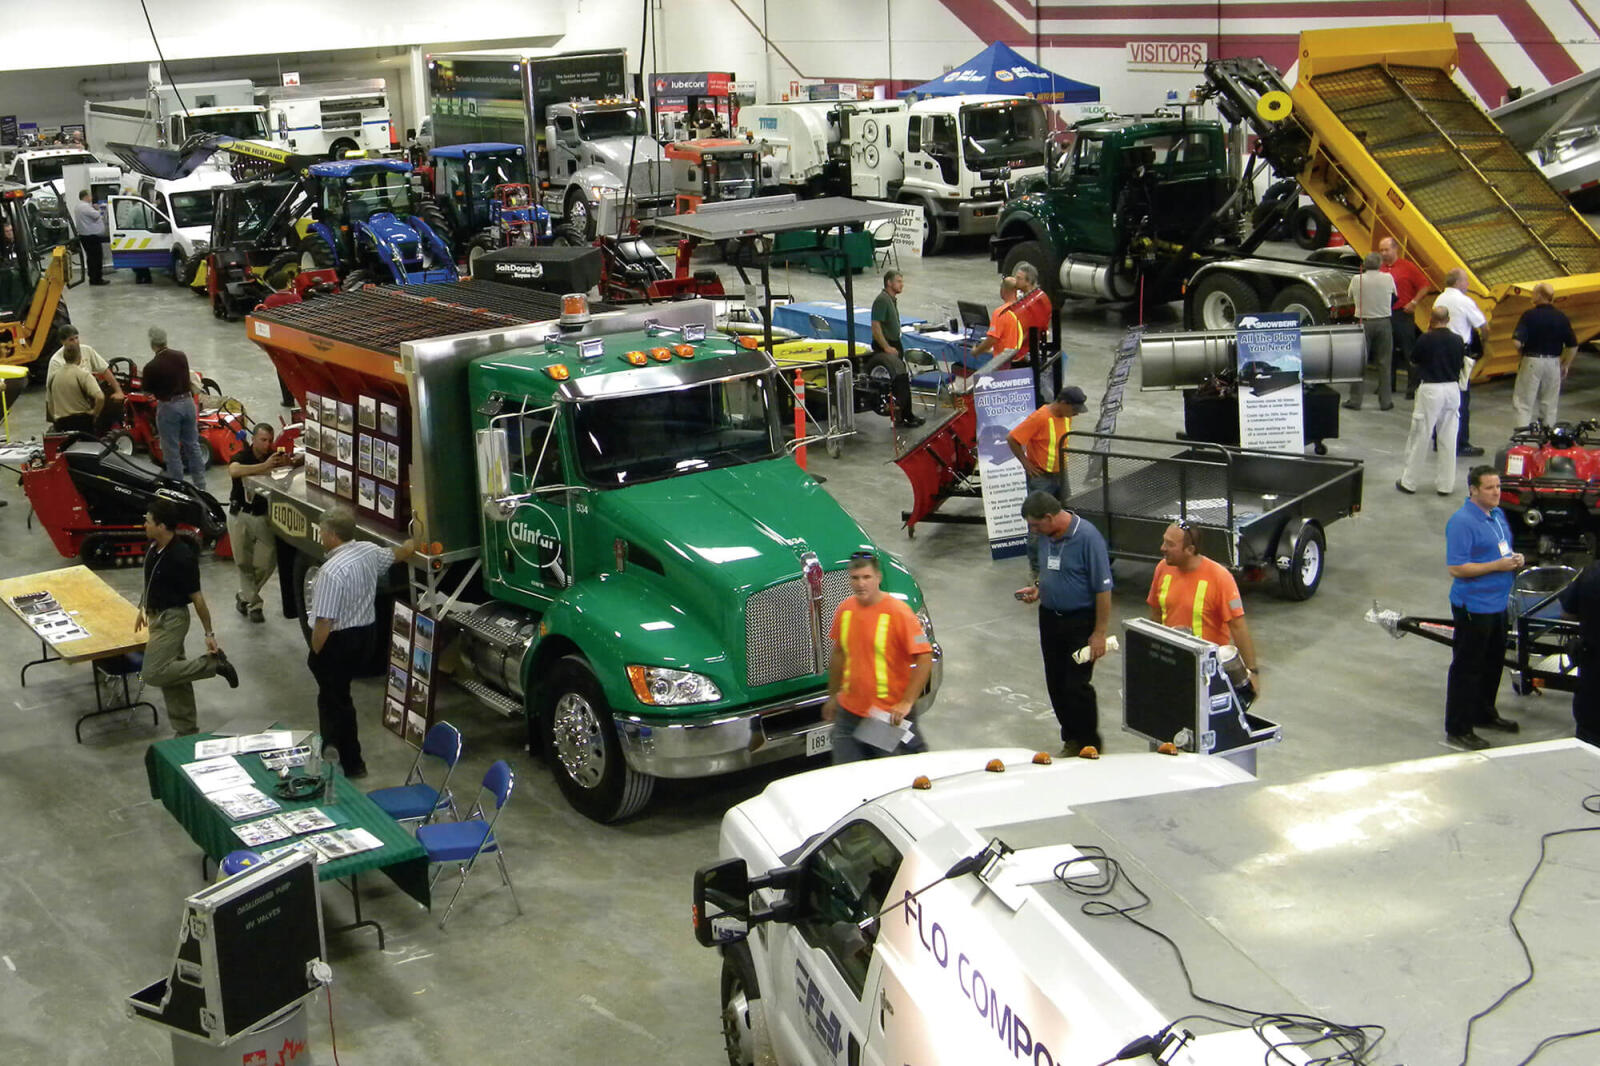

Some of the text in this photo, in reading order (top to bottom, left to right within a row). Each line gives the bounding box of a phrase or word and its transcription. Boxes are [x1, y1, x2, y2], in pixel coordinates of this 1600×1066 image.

[1130, 43, 1202, 63] VISITORS
[235, 143, 282, 161] NEW HOLLAND
[1256, 320, 1298, 328] SNOWBEAR
[1241, 332, 1297, 344] All The Plow
[1249, 342, 1292, 352] You Need
[978, 392, 1031, 407] All The Plow
[985, 403, 1027, 416] You Need
[576, 503, 588, 514] 534
[274, 505, 305, 532] ELOQUIP
[904, 889, 949, 969] FLO
